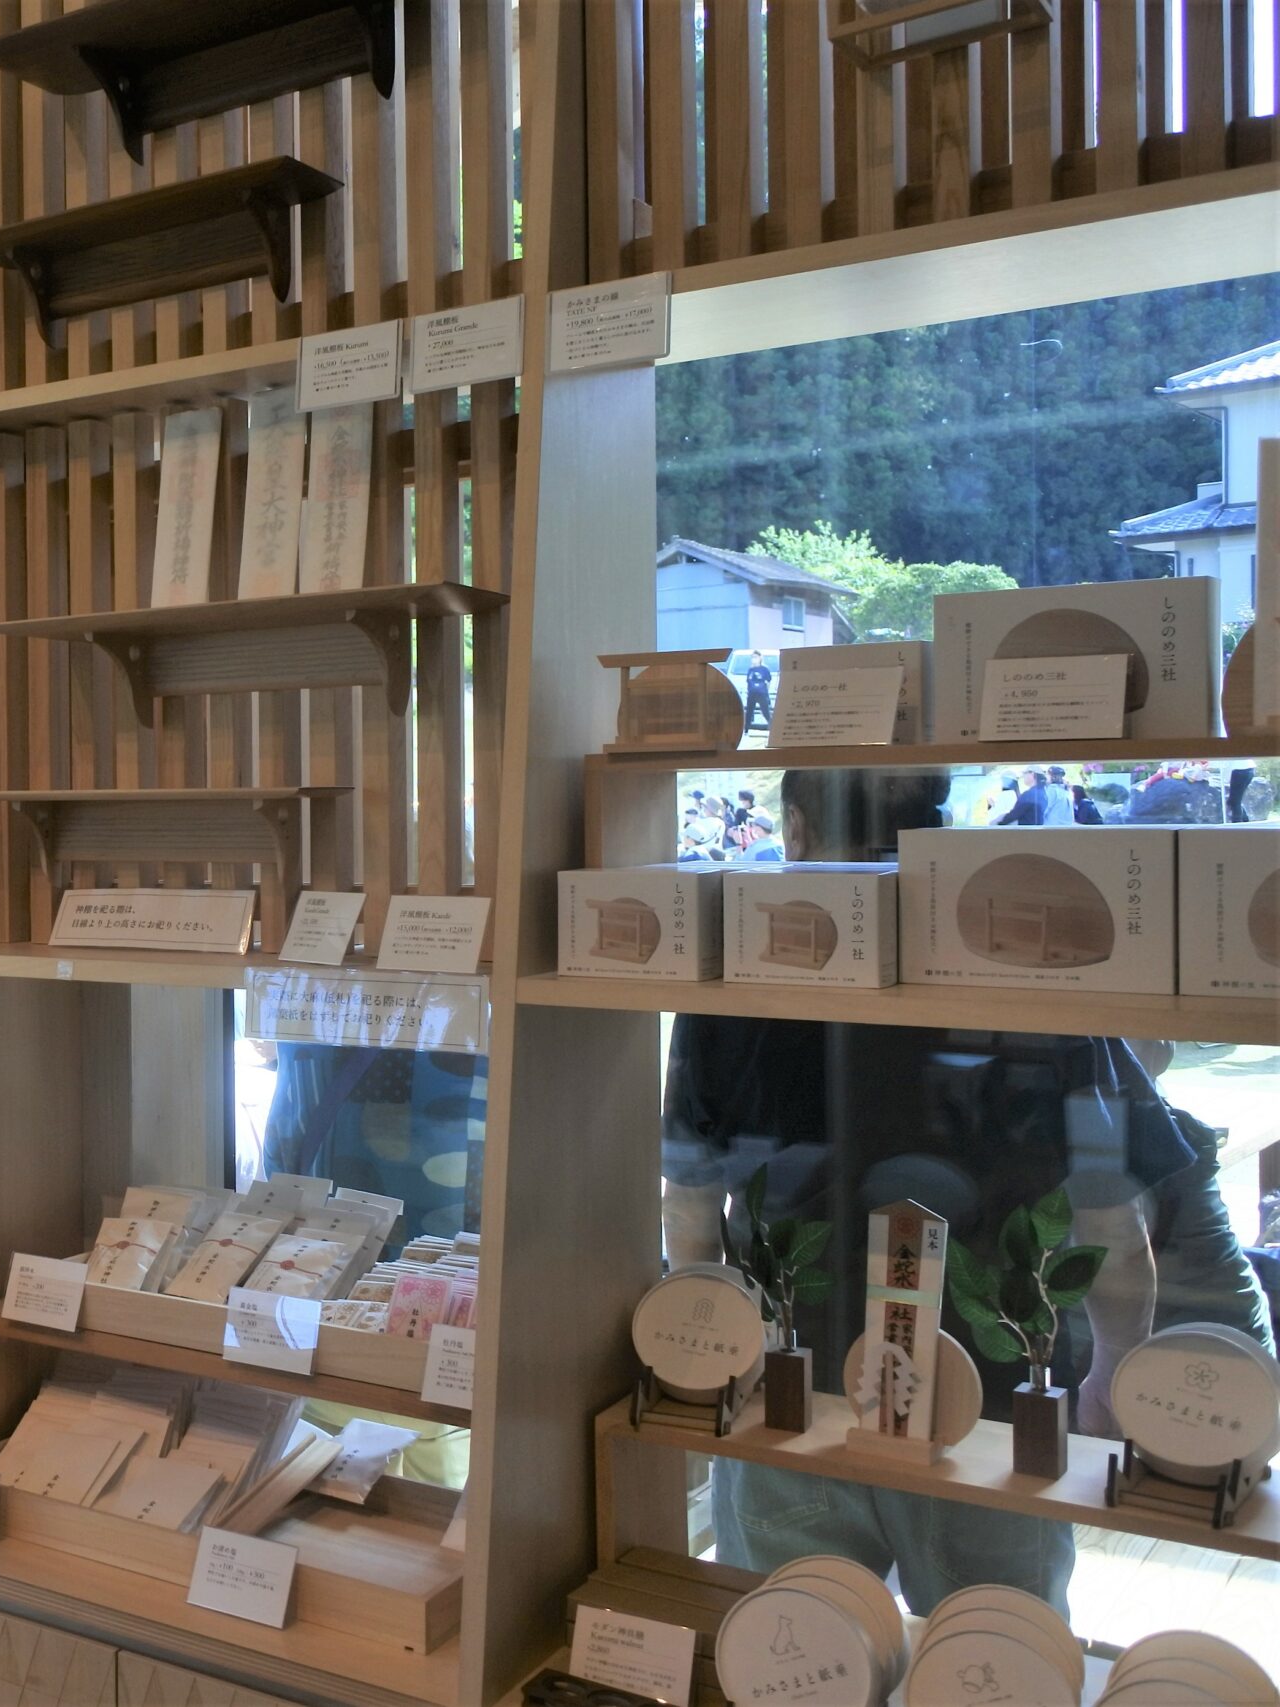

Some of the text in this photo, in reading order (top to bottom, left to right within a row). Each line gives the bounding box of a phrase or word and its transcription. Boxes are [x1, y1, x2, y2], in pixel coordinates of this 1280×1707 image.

[426, 315, 458, 330] 洋風棚板
[428, 321, 479, 338] Kurumi Grande
[314, 341, 369, 356] 洋風棚板 Kurumi
[1160, 596, 1177, 683] しののめ三社
[1003, 671, 1068, 683] しののめ三社
[792, 682, 848, 693] しののめ一社
[896, 651, 909, 722] しめ一社
[1126, 848, 1143, 936] しののめ三社
[75, 904, 136, 915] 神棚を祀る際は、
[399, 909, 430, 919] 洋風棚板
[72, 918, 214, 933] 目線より上の高さにお祀りください。
[674, 883, 686, 956] しののめ一社
[851, 885, 865, 961] しののめ一社
[927, 1228, 939, 1251] 見本
[442, 1338, 464, 1349] 牡丹塩
[212, 1543, 238, 1556] お清め塩
